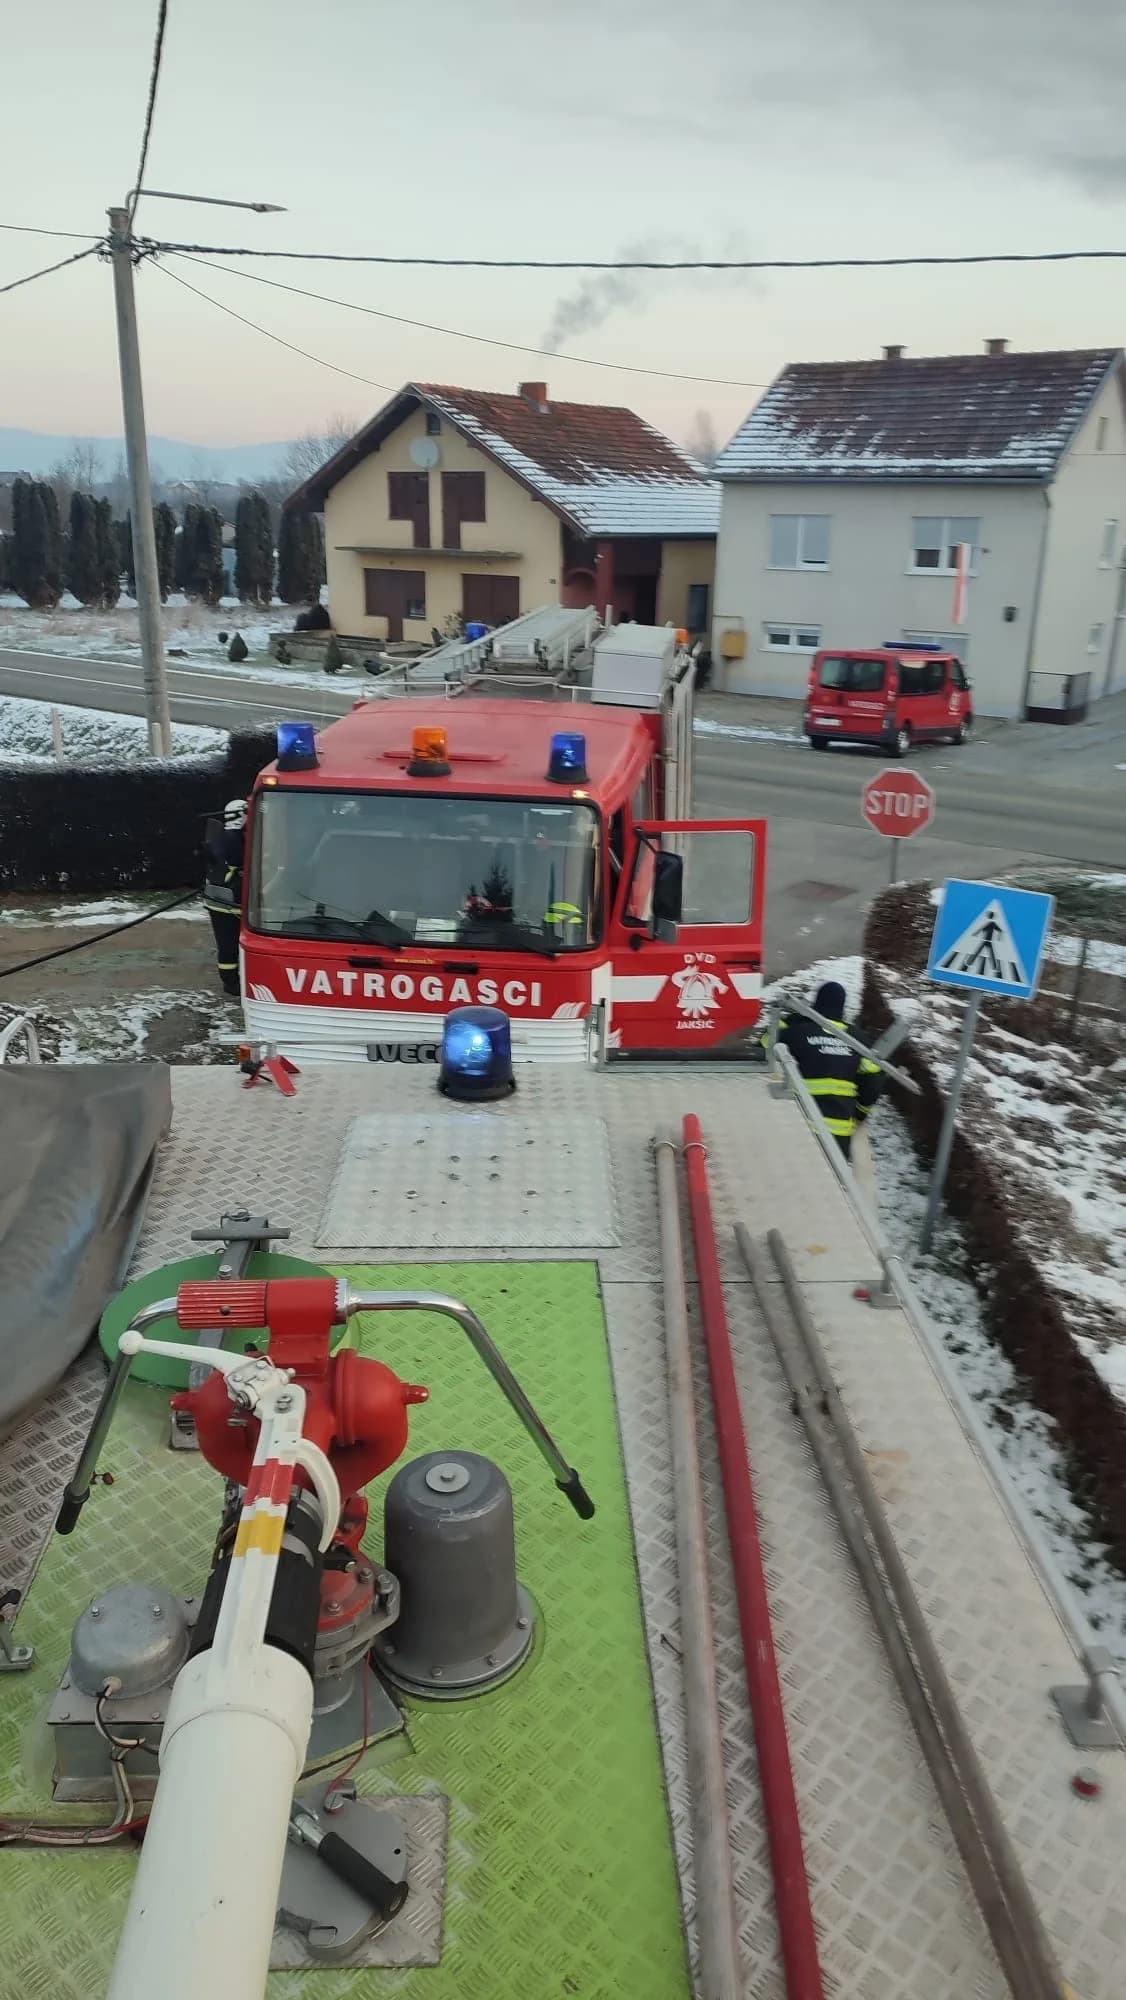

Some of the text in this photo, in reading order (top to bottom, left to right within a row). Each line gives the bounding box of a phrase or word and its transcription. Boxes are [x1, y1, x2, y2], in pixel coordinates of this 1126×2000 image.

[866, 790, 929, 818] STOP
[683, 952, 717, 964] DVD
[285, 967, 543, 1007] VATROGASCI
